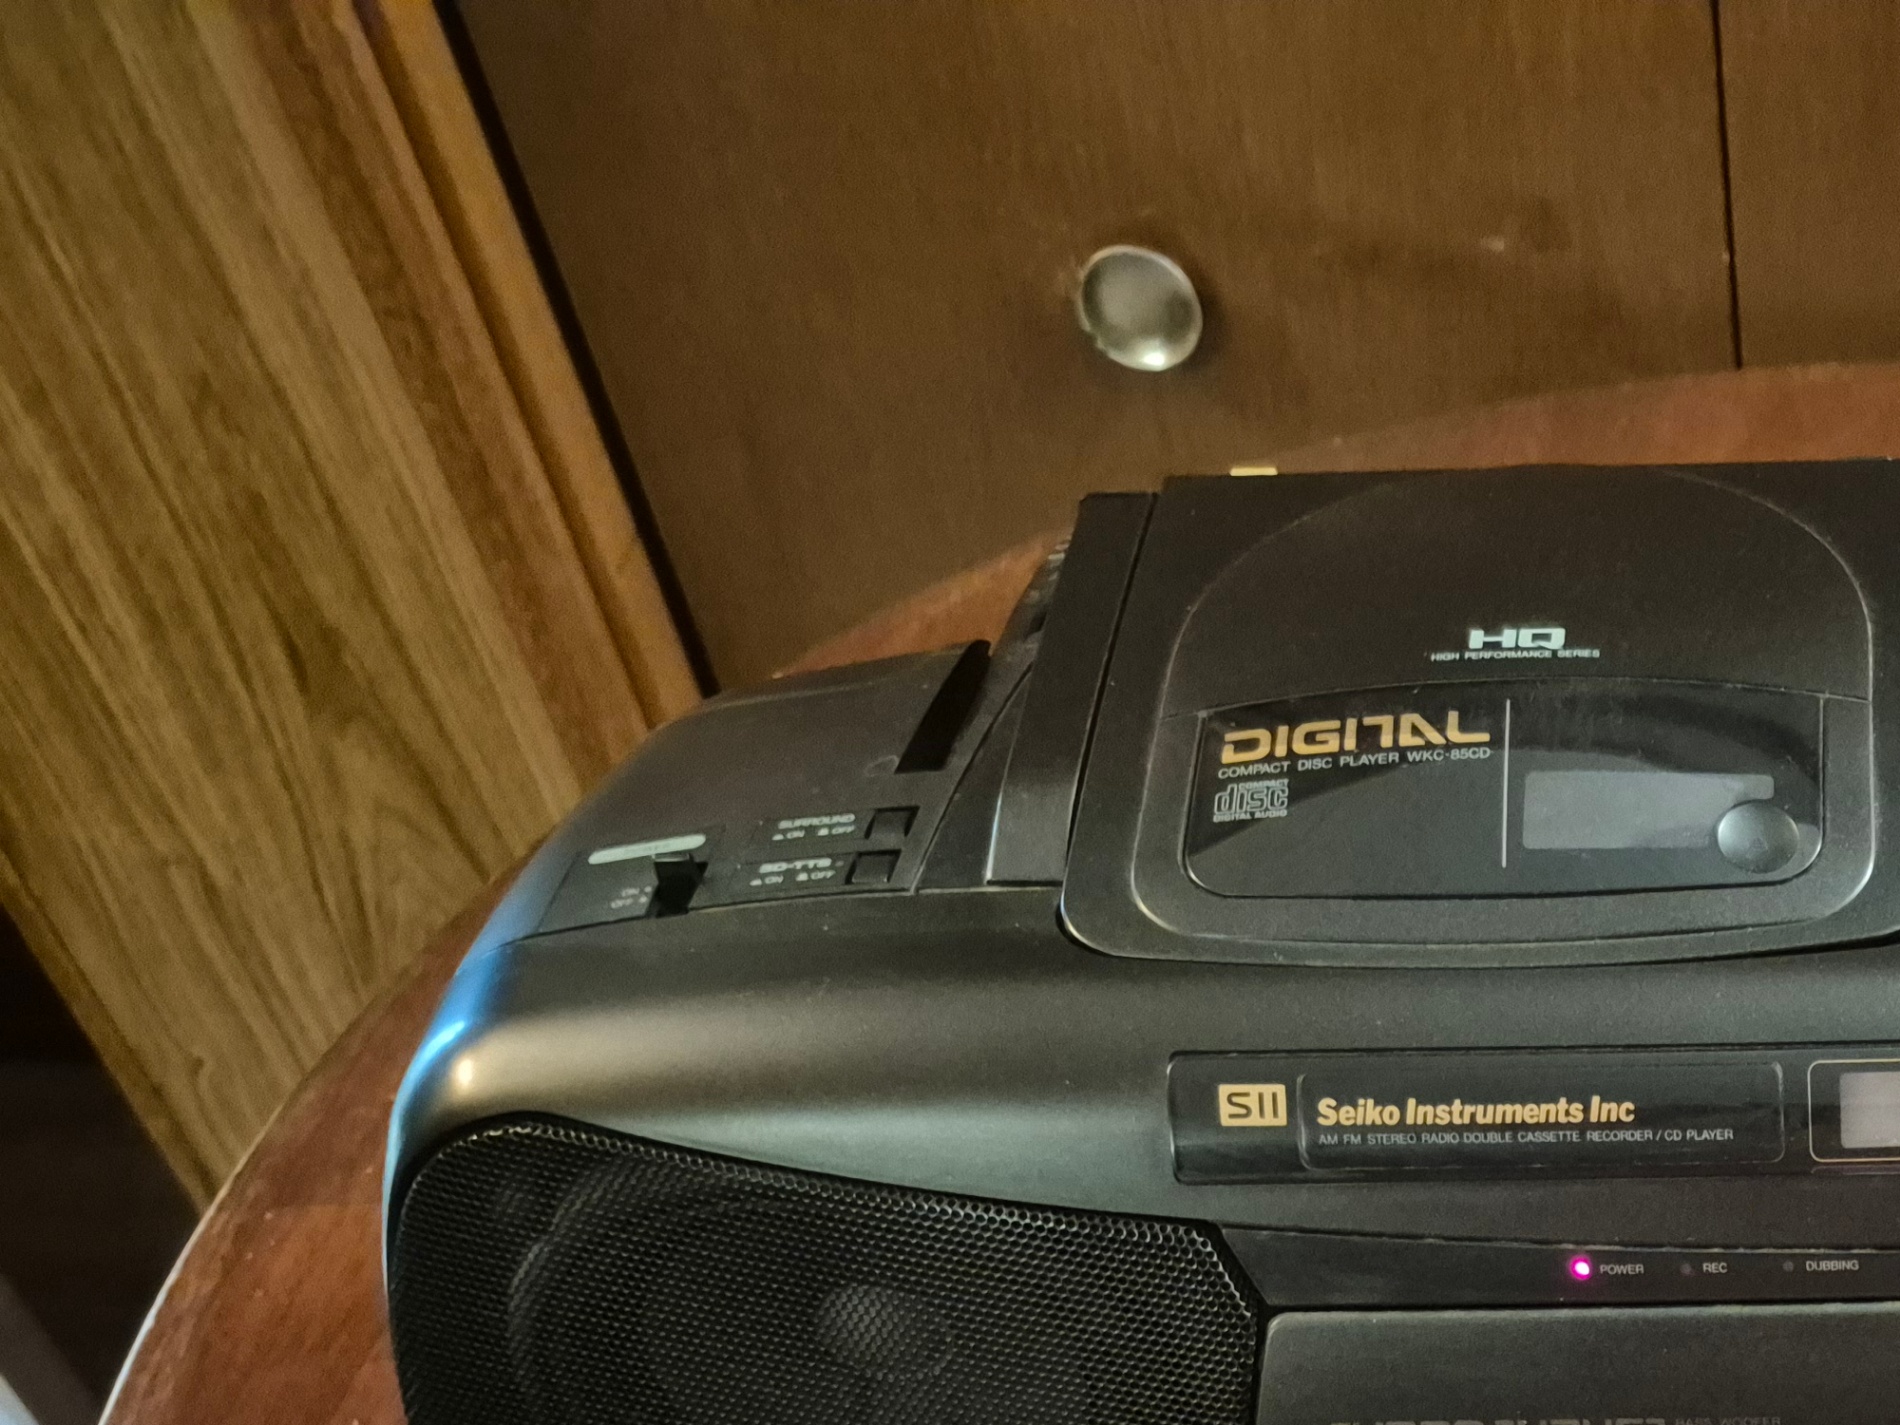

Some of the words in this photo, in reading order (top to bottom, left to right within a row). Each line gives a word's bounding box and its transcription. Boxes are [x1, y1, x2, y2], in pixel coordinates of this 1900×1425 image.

[1467, 627, 1567, 650] HQ
[1430, 651, 1460, 663] HIGH
[1463, 650, 1552, 661] PERFORMANCE
[1557, 649, 1601, 659] SERIES
[1220, 710, 1491, 765] DIGITAL
[1217, 759, 1290, 778] COMPACT
[1296, 757, 1333, 773] DISC
[1339, 751, 1400, 769] PLAYER
[1407, 745, 1491, 763] WKC-85CD
[1239, 778, 1290, 791] COMPACT
[1214, 784, 1289, 813] disc
[778, 812, 856, 830] SURROUND
[1213, 812, 1252, 824] DIGITAL
[1254, 809, 1289, 819] AUDIO
[1316, 1096, 1401, 1127] Seiko
[1404, 1096, 1585, 1126] Instruments
[1588, 1095, 1636, 1123] Inc
[1319, 1133, 1338, 1146] AM
[1343, 1133, 1362, 1146] FM
[1367, 1133, 1417, 1146] STEREO
[1421, 1132, 1460, 1145] RADIO
[1463, 1131, 1513, 1145] DOUBLE
[1518, 1130, 1581, 1143] CASSETTE
[1586, 1129, 1653, 1142] RECORDER
[1664, 1129, 1683, 1141] CD
[1686, 1128, 1734, 1141] PLAYER
[1600, 1263, 1645, 1275] POWER
[1702, 1262, 1728, 1274] REC
[1805, 1259, 1860, 1272] DUBBING
